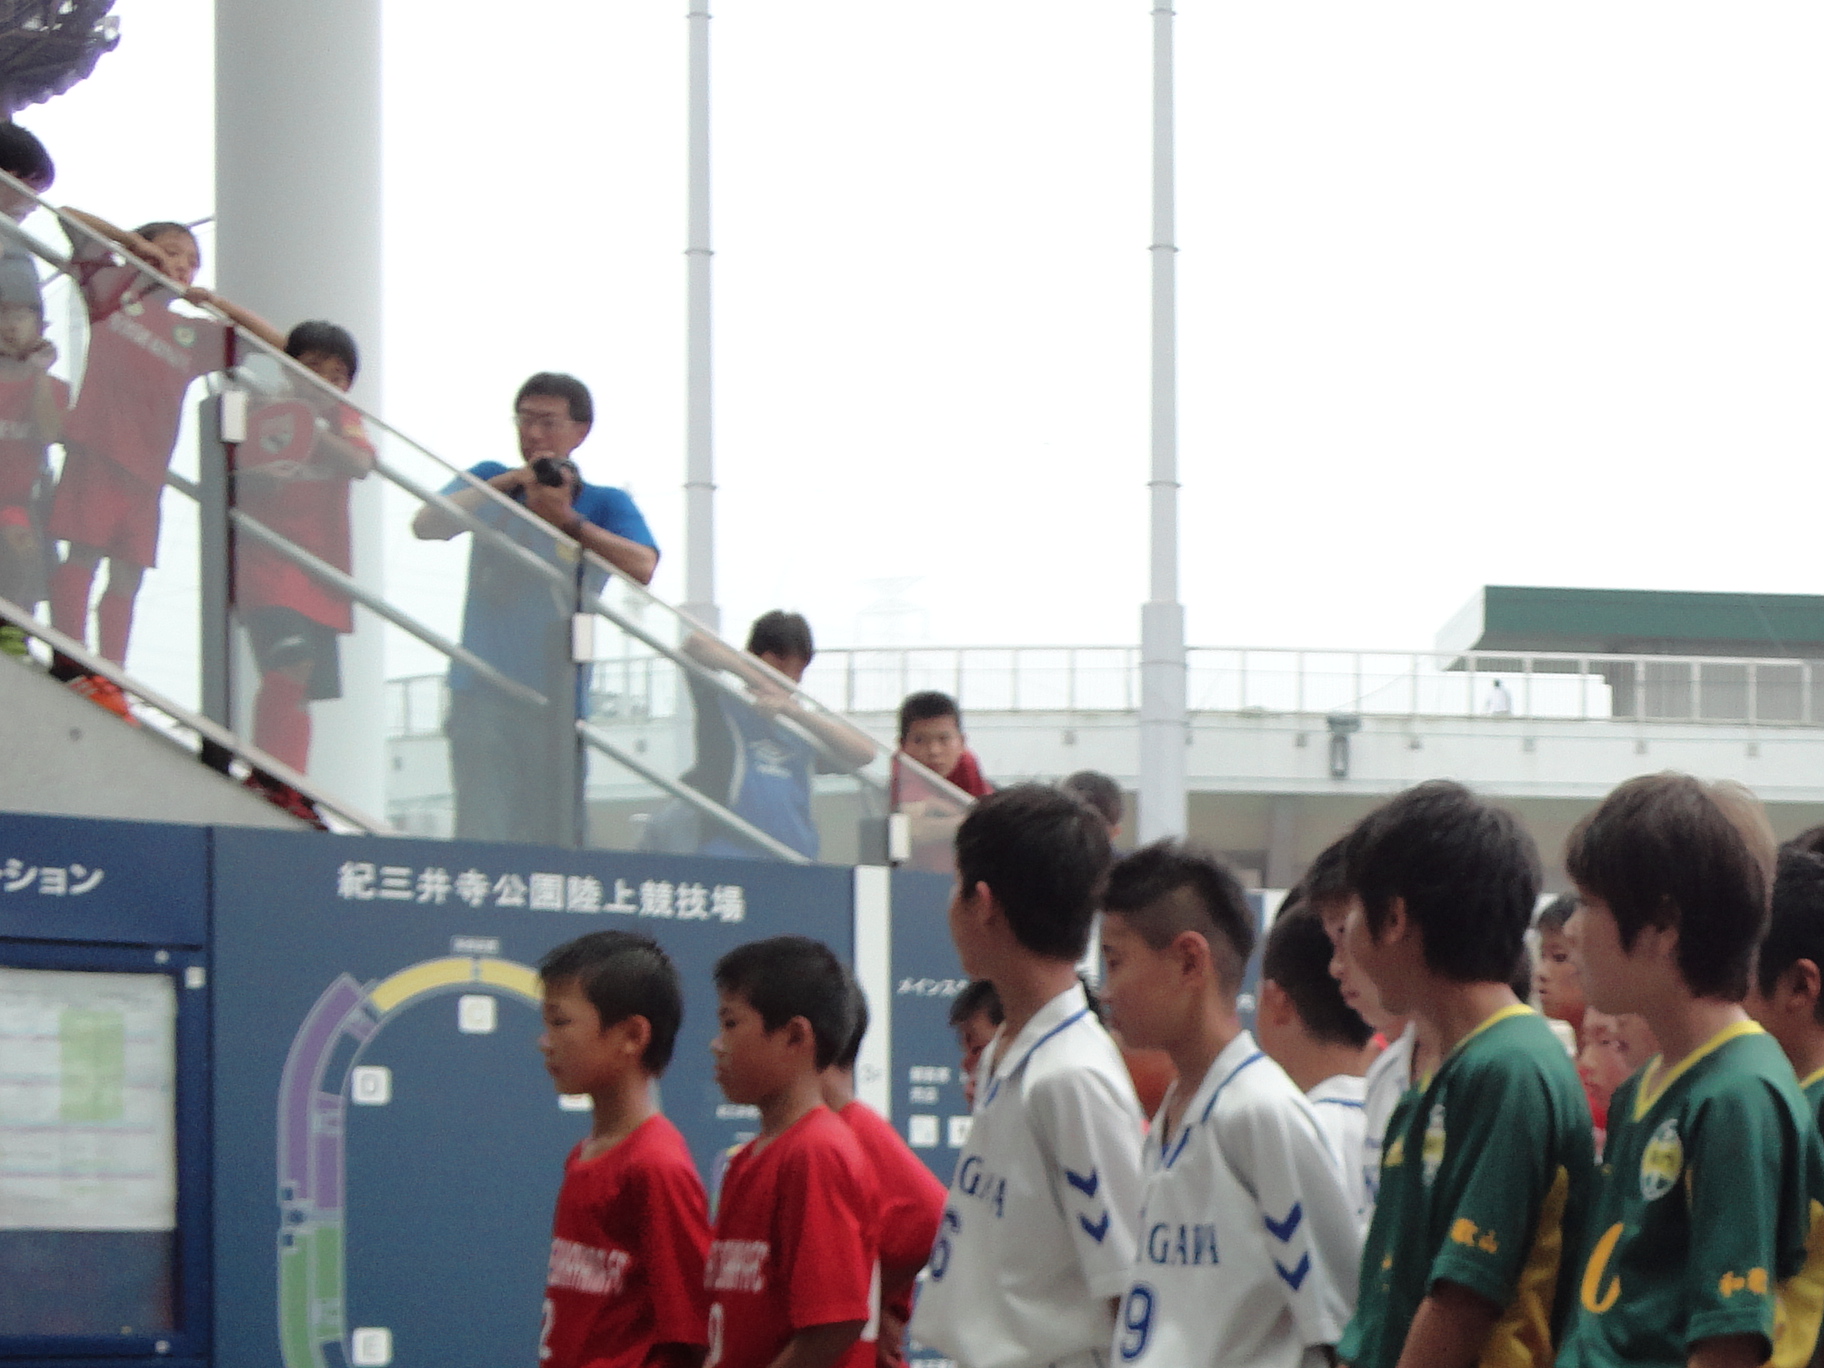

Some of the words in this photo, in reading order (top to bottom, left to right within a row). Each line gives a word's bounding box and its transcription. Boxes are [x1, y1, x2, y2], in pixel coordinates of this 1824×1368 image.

[0, 857, 105, 896] ション
[337, 860, 747, 923] 紀三井寺公園陸上競技場
[1119, 1283, 1157, 1363] 9
